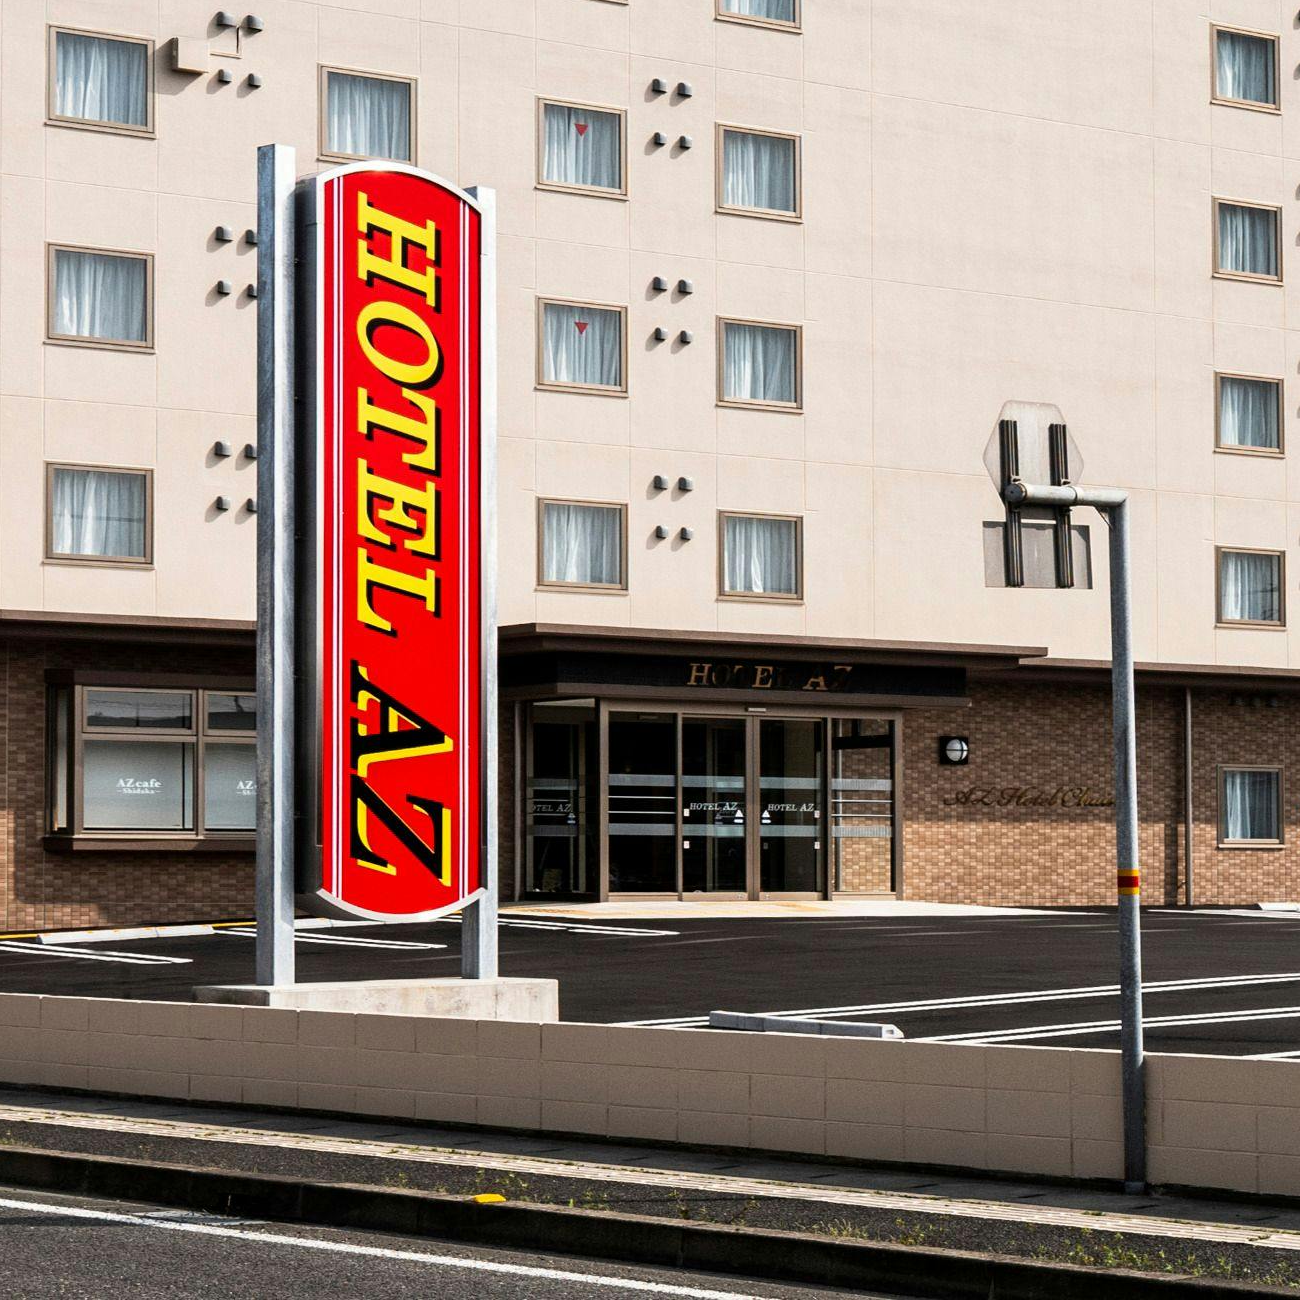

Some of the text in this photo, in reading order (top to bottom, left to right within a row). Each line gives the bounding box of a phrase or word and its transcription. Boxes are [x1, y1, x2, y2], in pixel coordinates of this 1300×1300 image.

[349, 191, 453, 888] HOTEL AZ
[690, 802, 721, 811] HOTEL
[767, 803, 815, 812] HOTEL AZ
